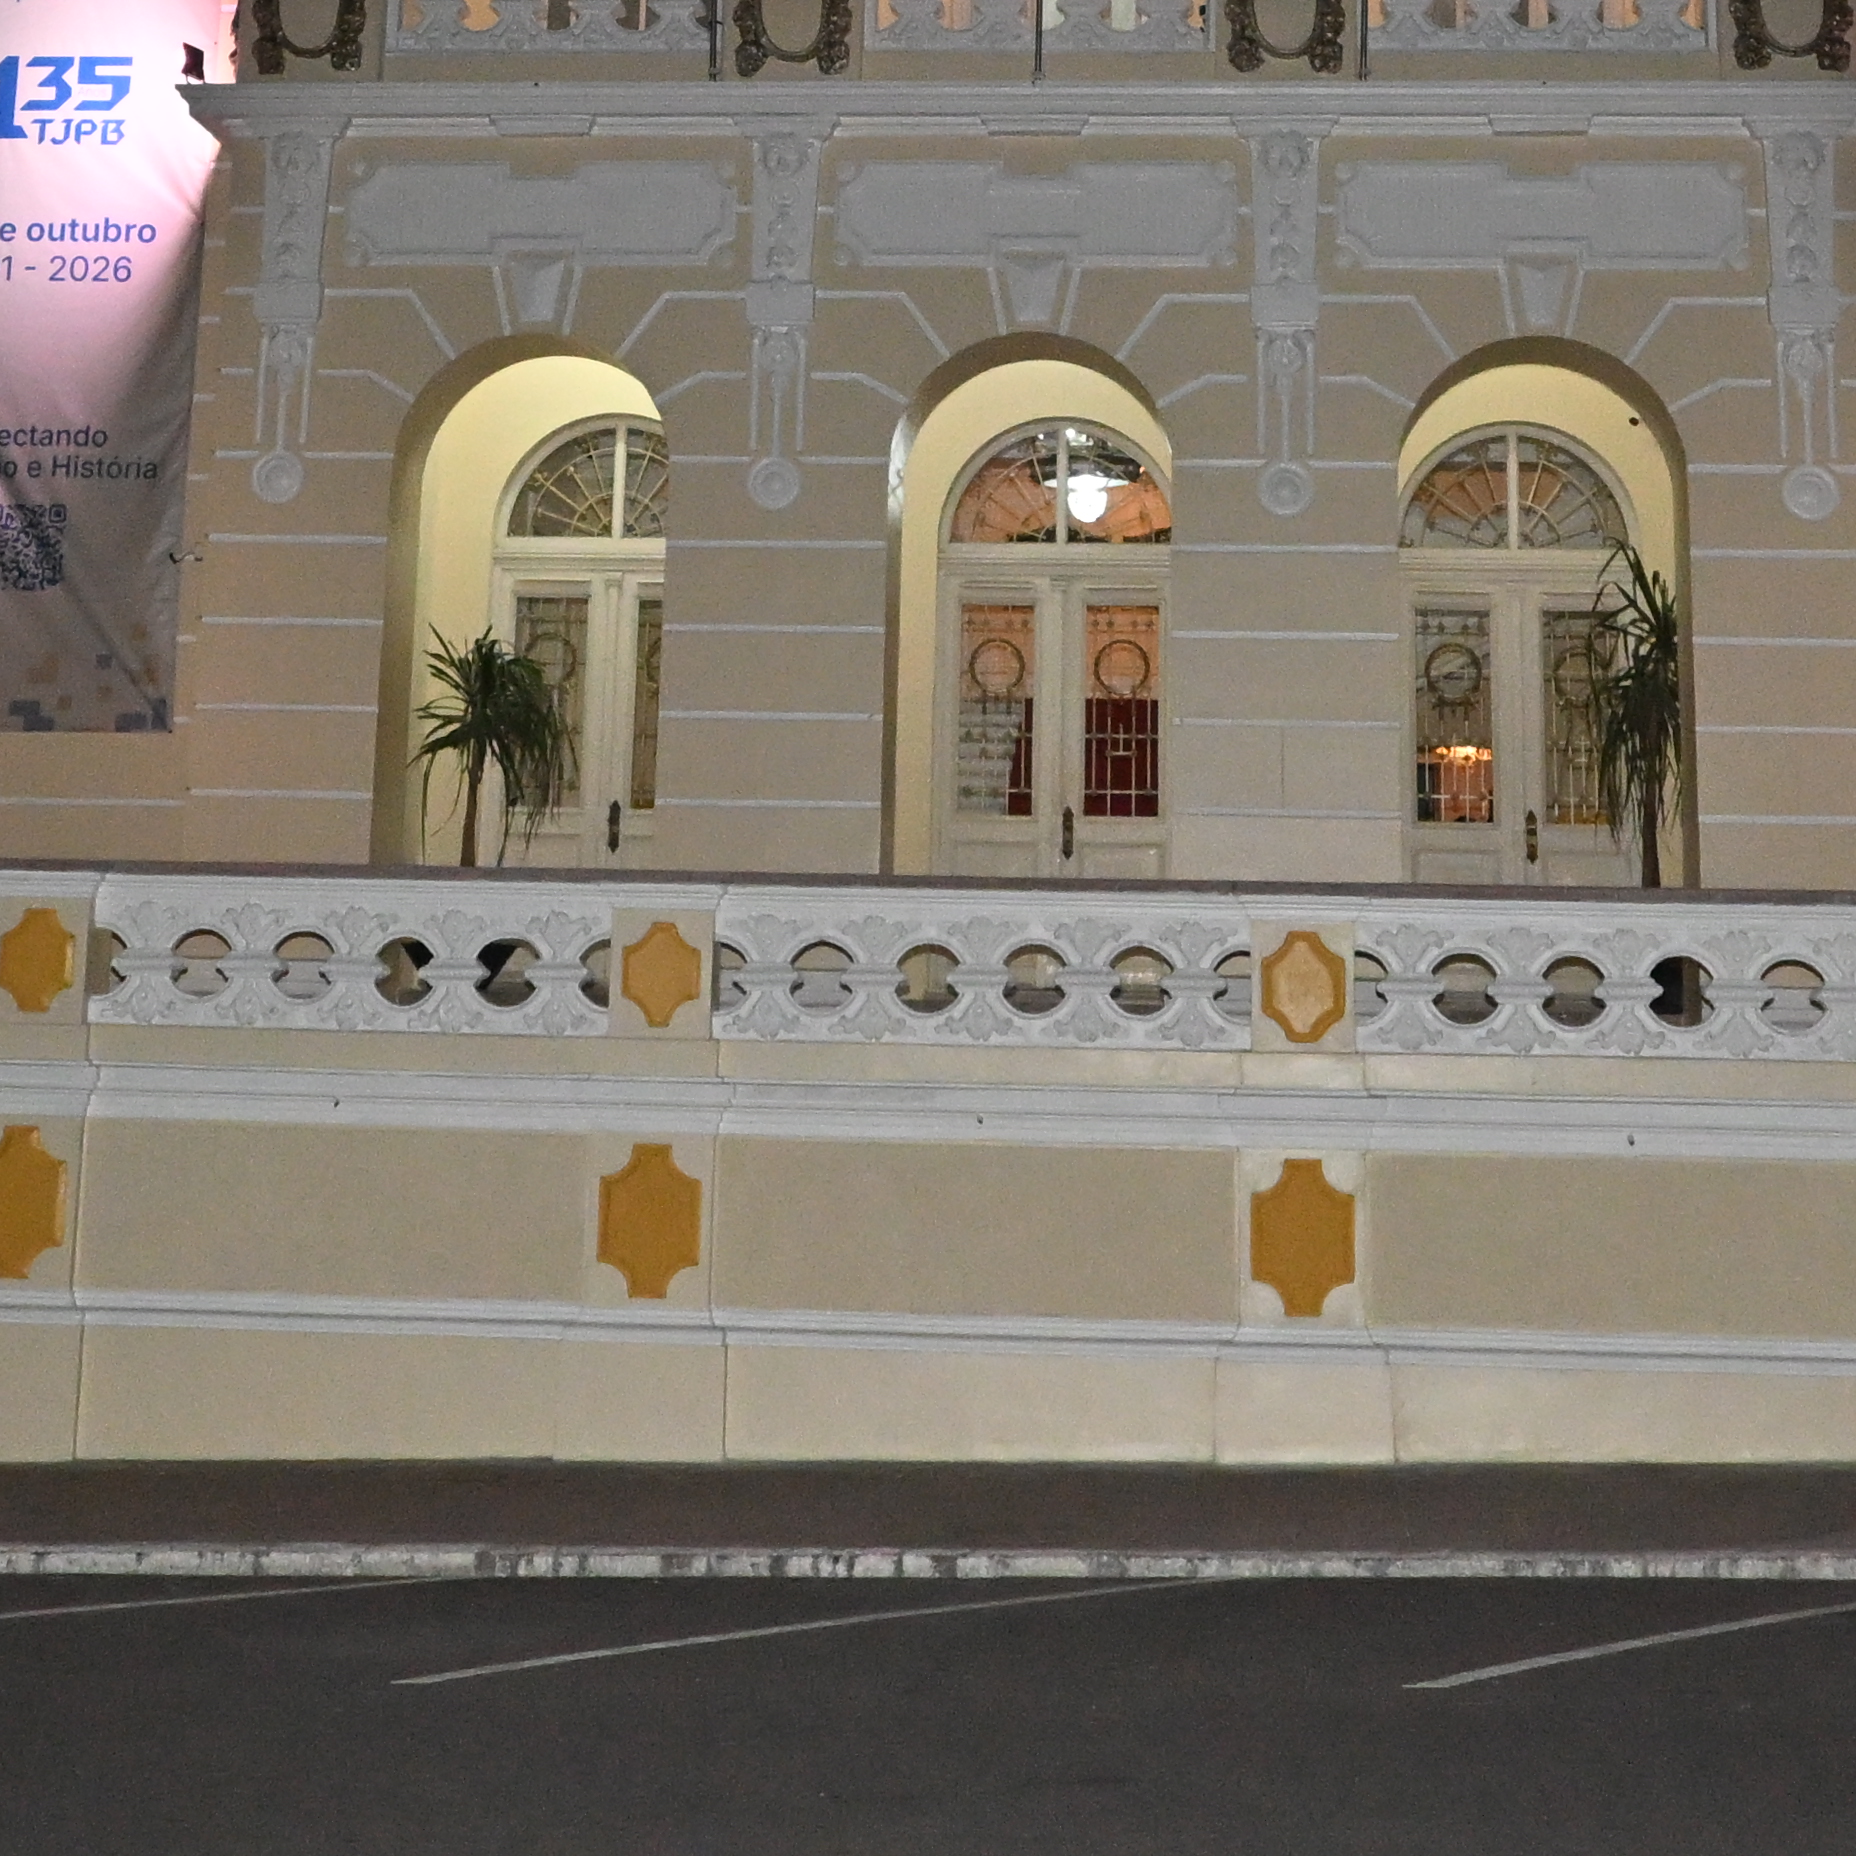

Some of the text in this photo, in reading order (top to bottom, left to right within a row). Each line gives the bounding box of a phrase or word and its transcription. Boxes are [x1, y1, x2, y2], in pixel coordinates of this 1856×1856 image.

[30, 118, 127, 145] TJPB
[26, 217, 157, 244] outubro
[48, 255, 132, 283] 2026
[27, 459, 42, 478] e
[51, 454, 158, 480] História
